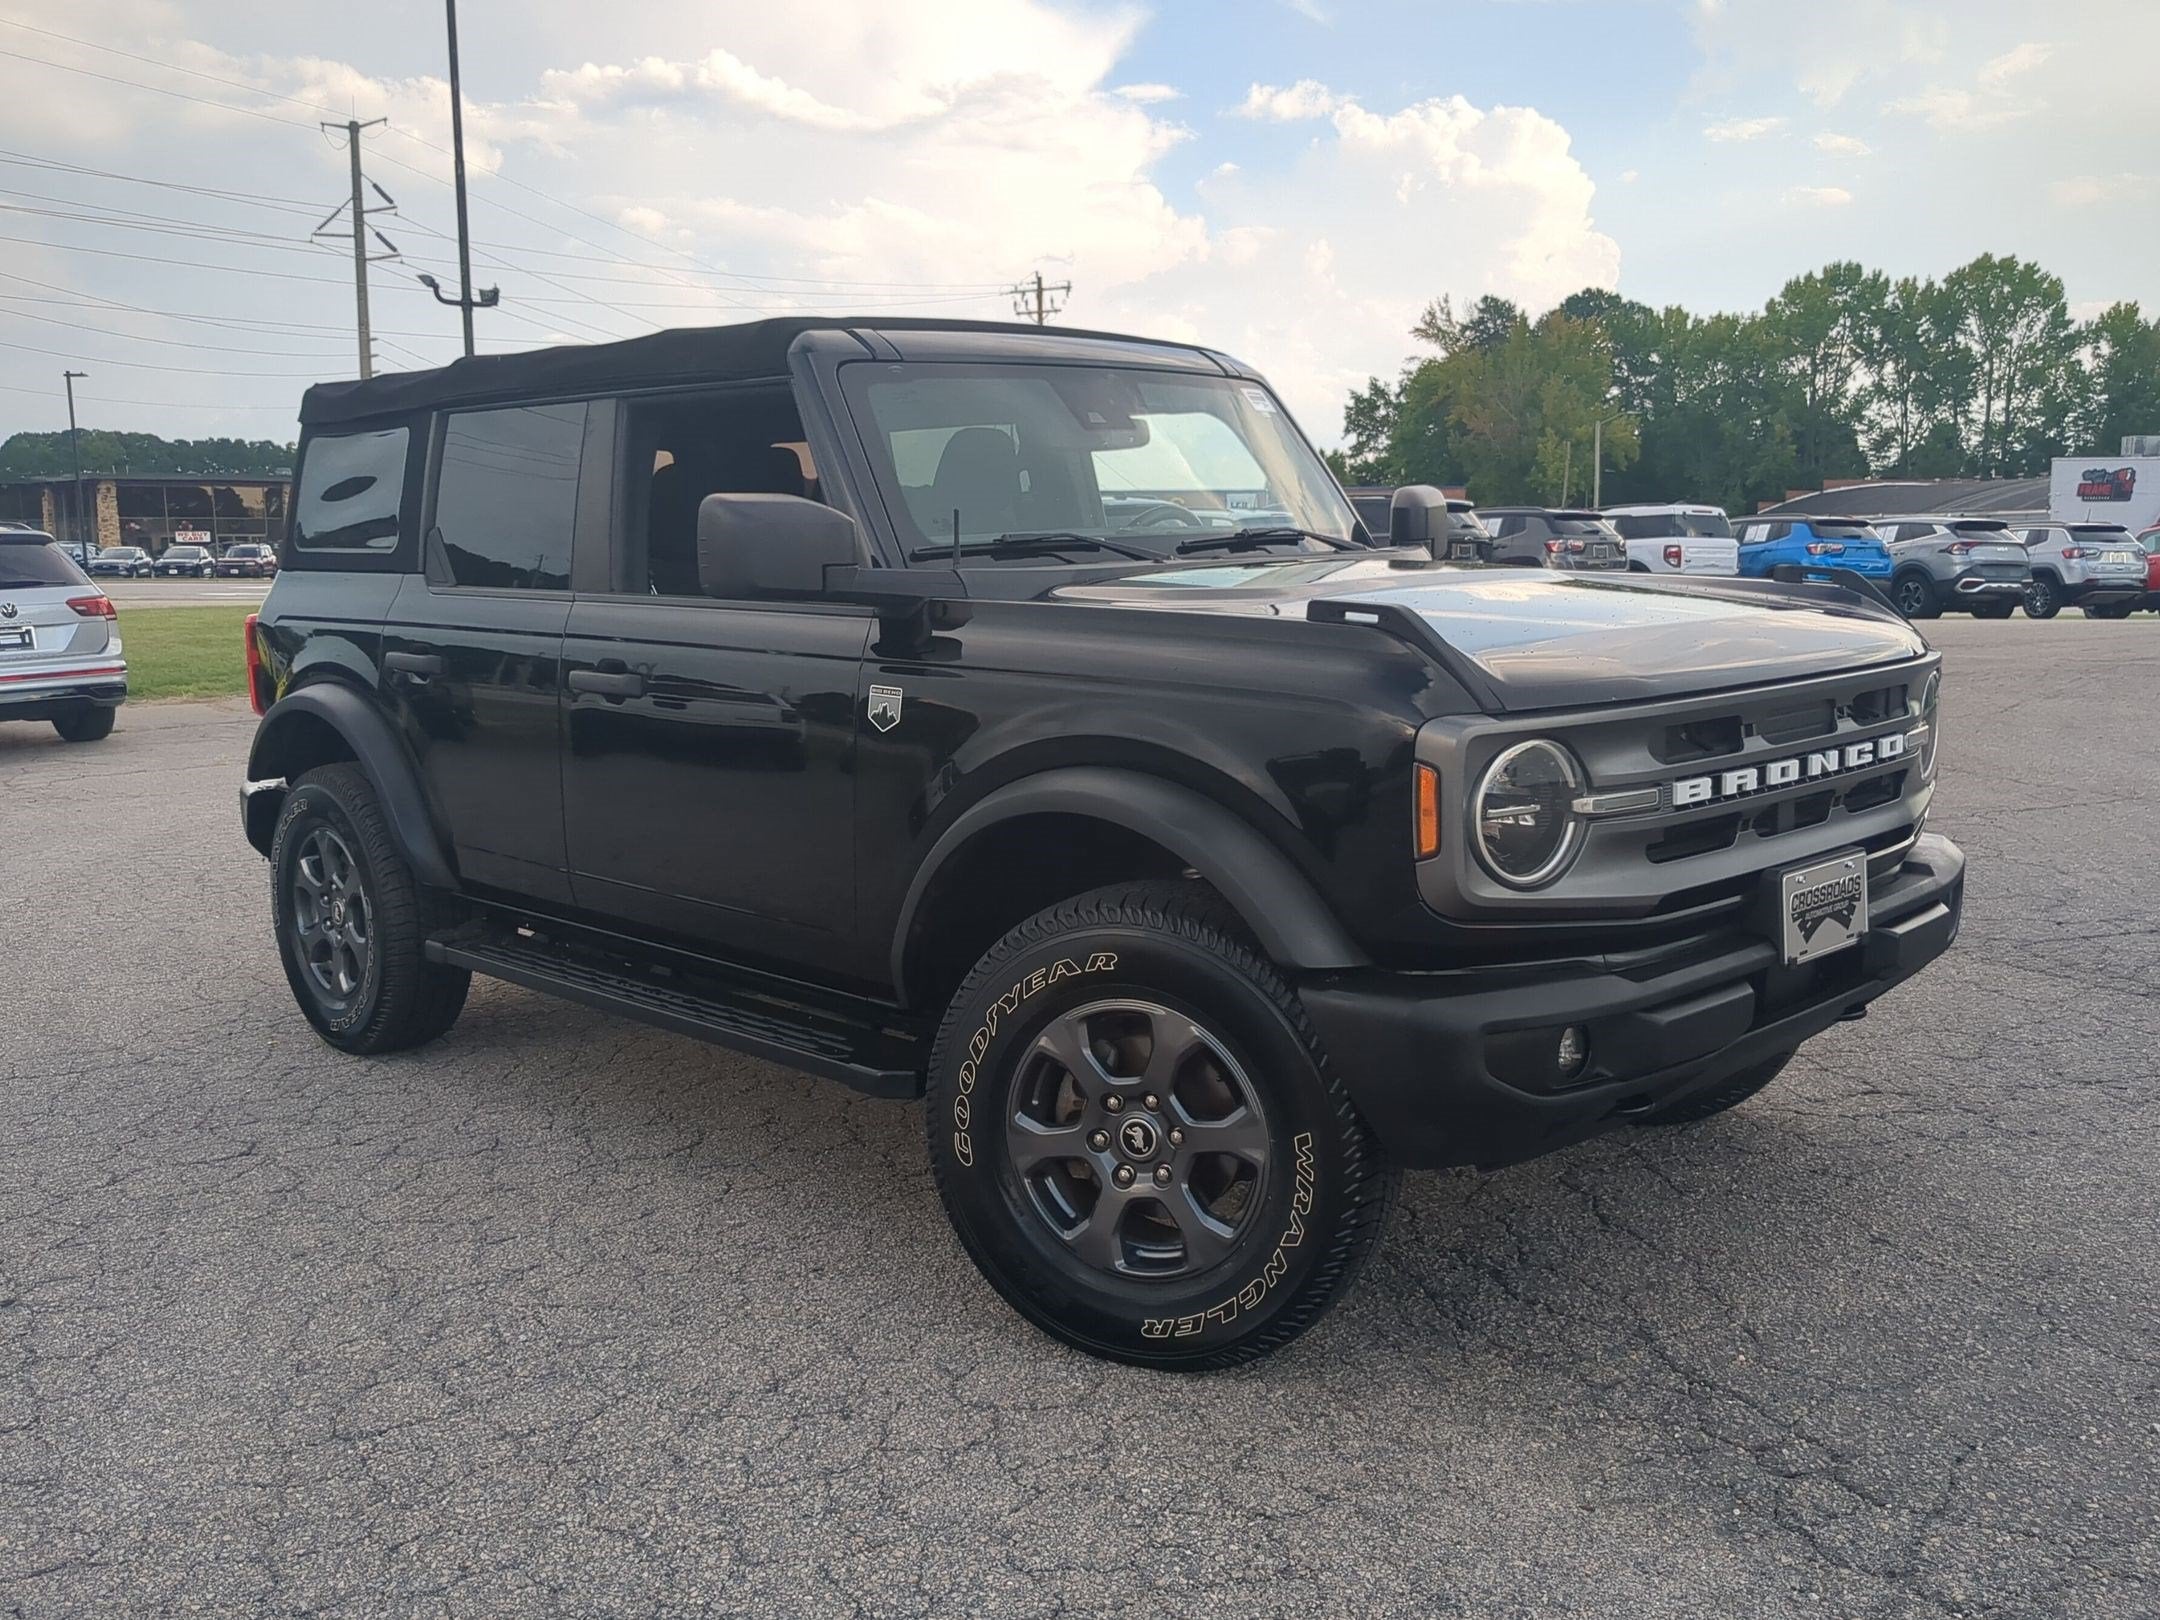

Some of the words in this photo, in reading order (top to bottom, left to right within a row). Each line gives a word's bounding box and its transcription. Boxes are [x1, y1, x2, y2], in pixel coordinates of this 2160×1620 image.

[1673, 734, 1903, 806] BRONCO
[1790, 873, 1861, 913] CROSSROADS
[955, 953, 1118, 1167] GOODYEAR
[1141, 1132, 1315, 1338] WRANGLER
